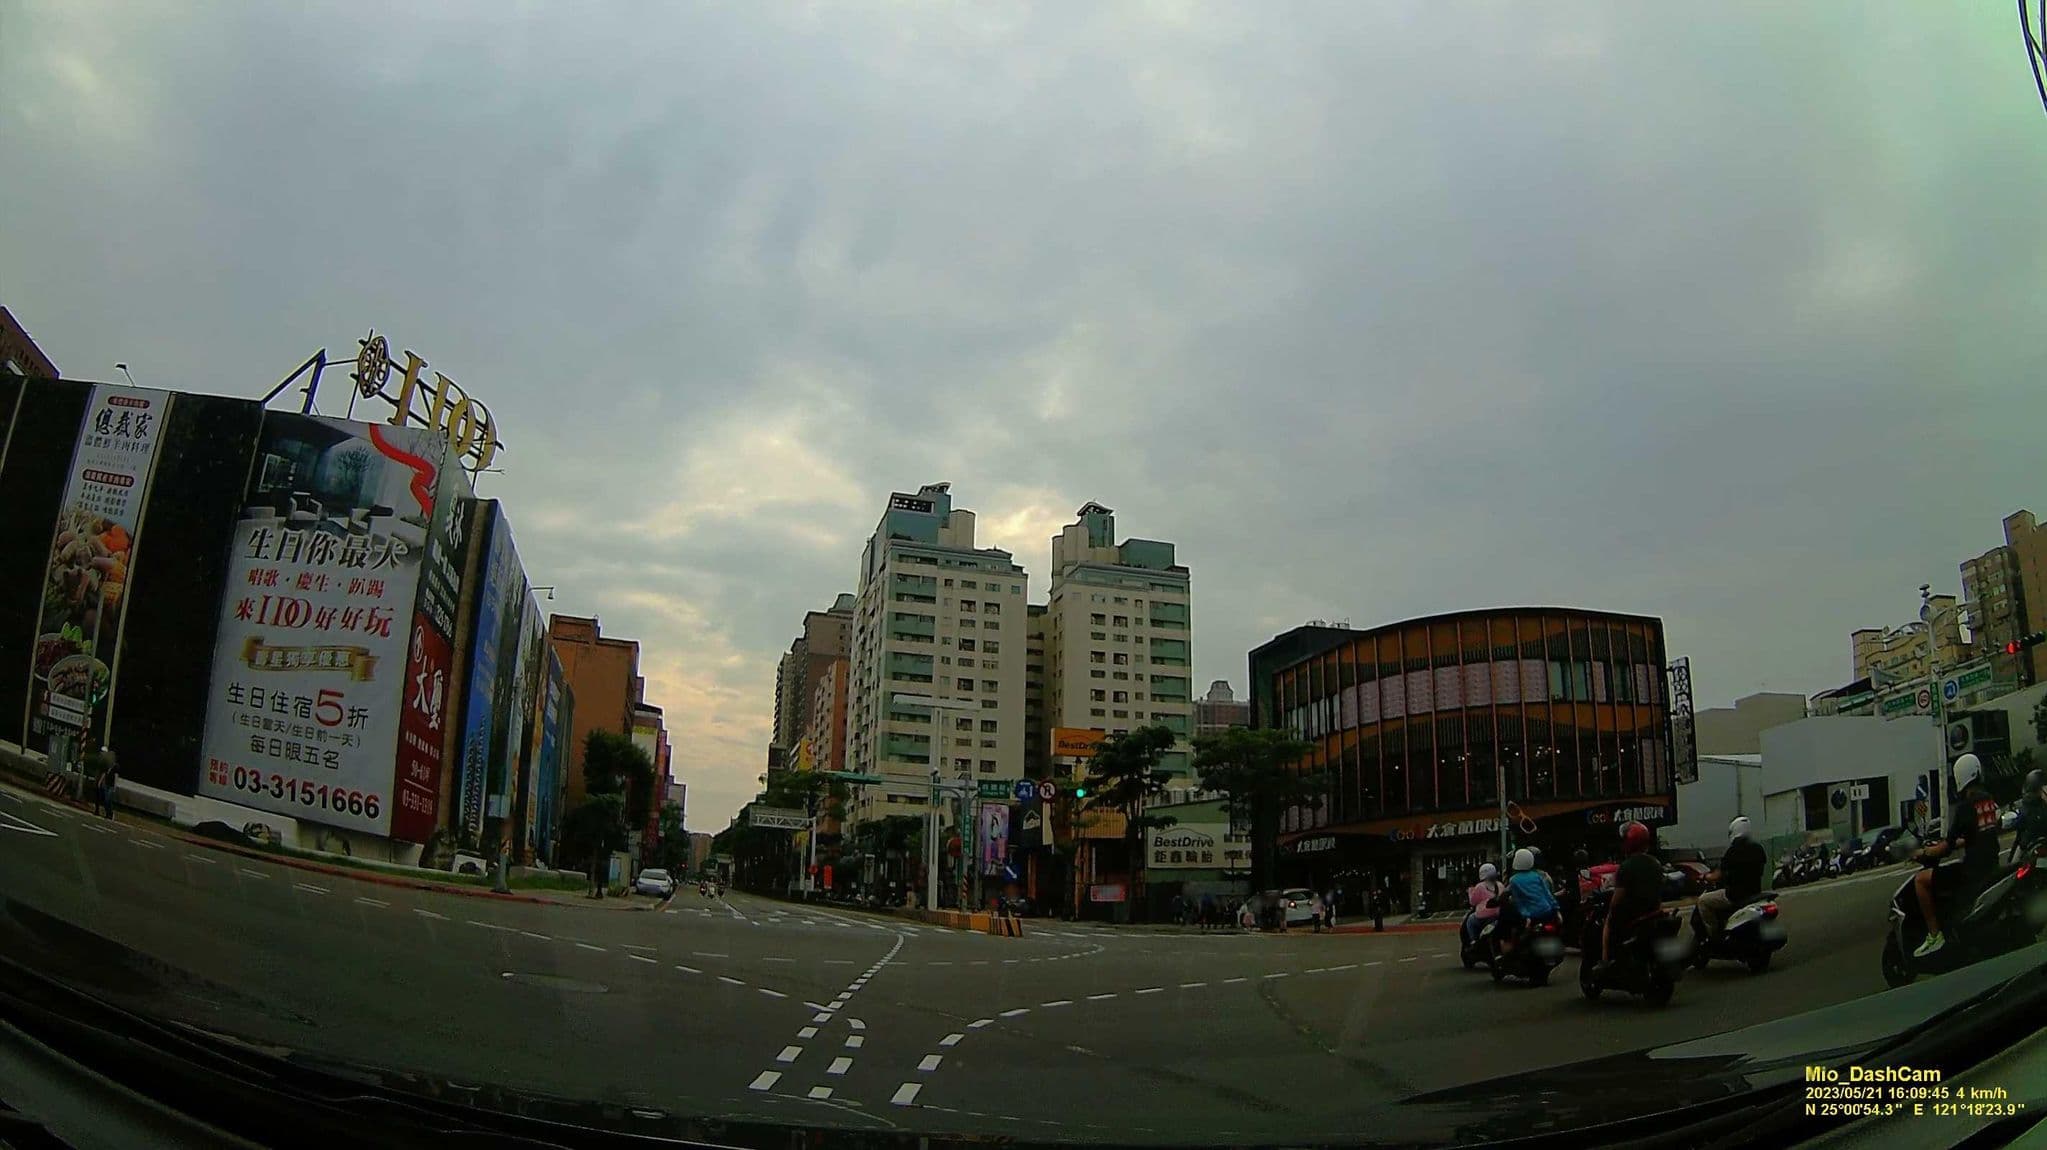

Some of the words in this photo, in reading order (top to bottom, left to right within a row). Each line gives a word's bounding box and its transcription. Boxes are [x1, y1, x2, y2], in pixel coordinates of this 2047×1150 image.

[245, 527, 409, 571] 生日你最大
[227, 682, 369, 731] 生日住宿5折
[233, 766, 380, 820] 03-3151666
[1153, 836, 1214, 848] BestDrive
